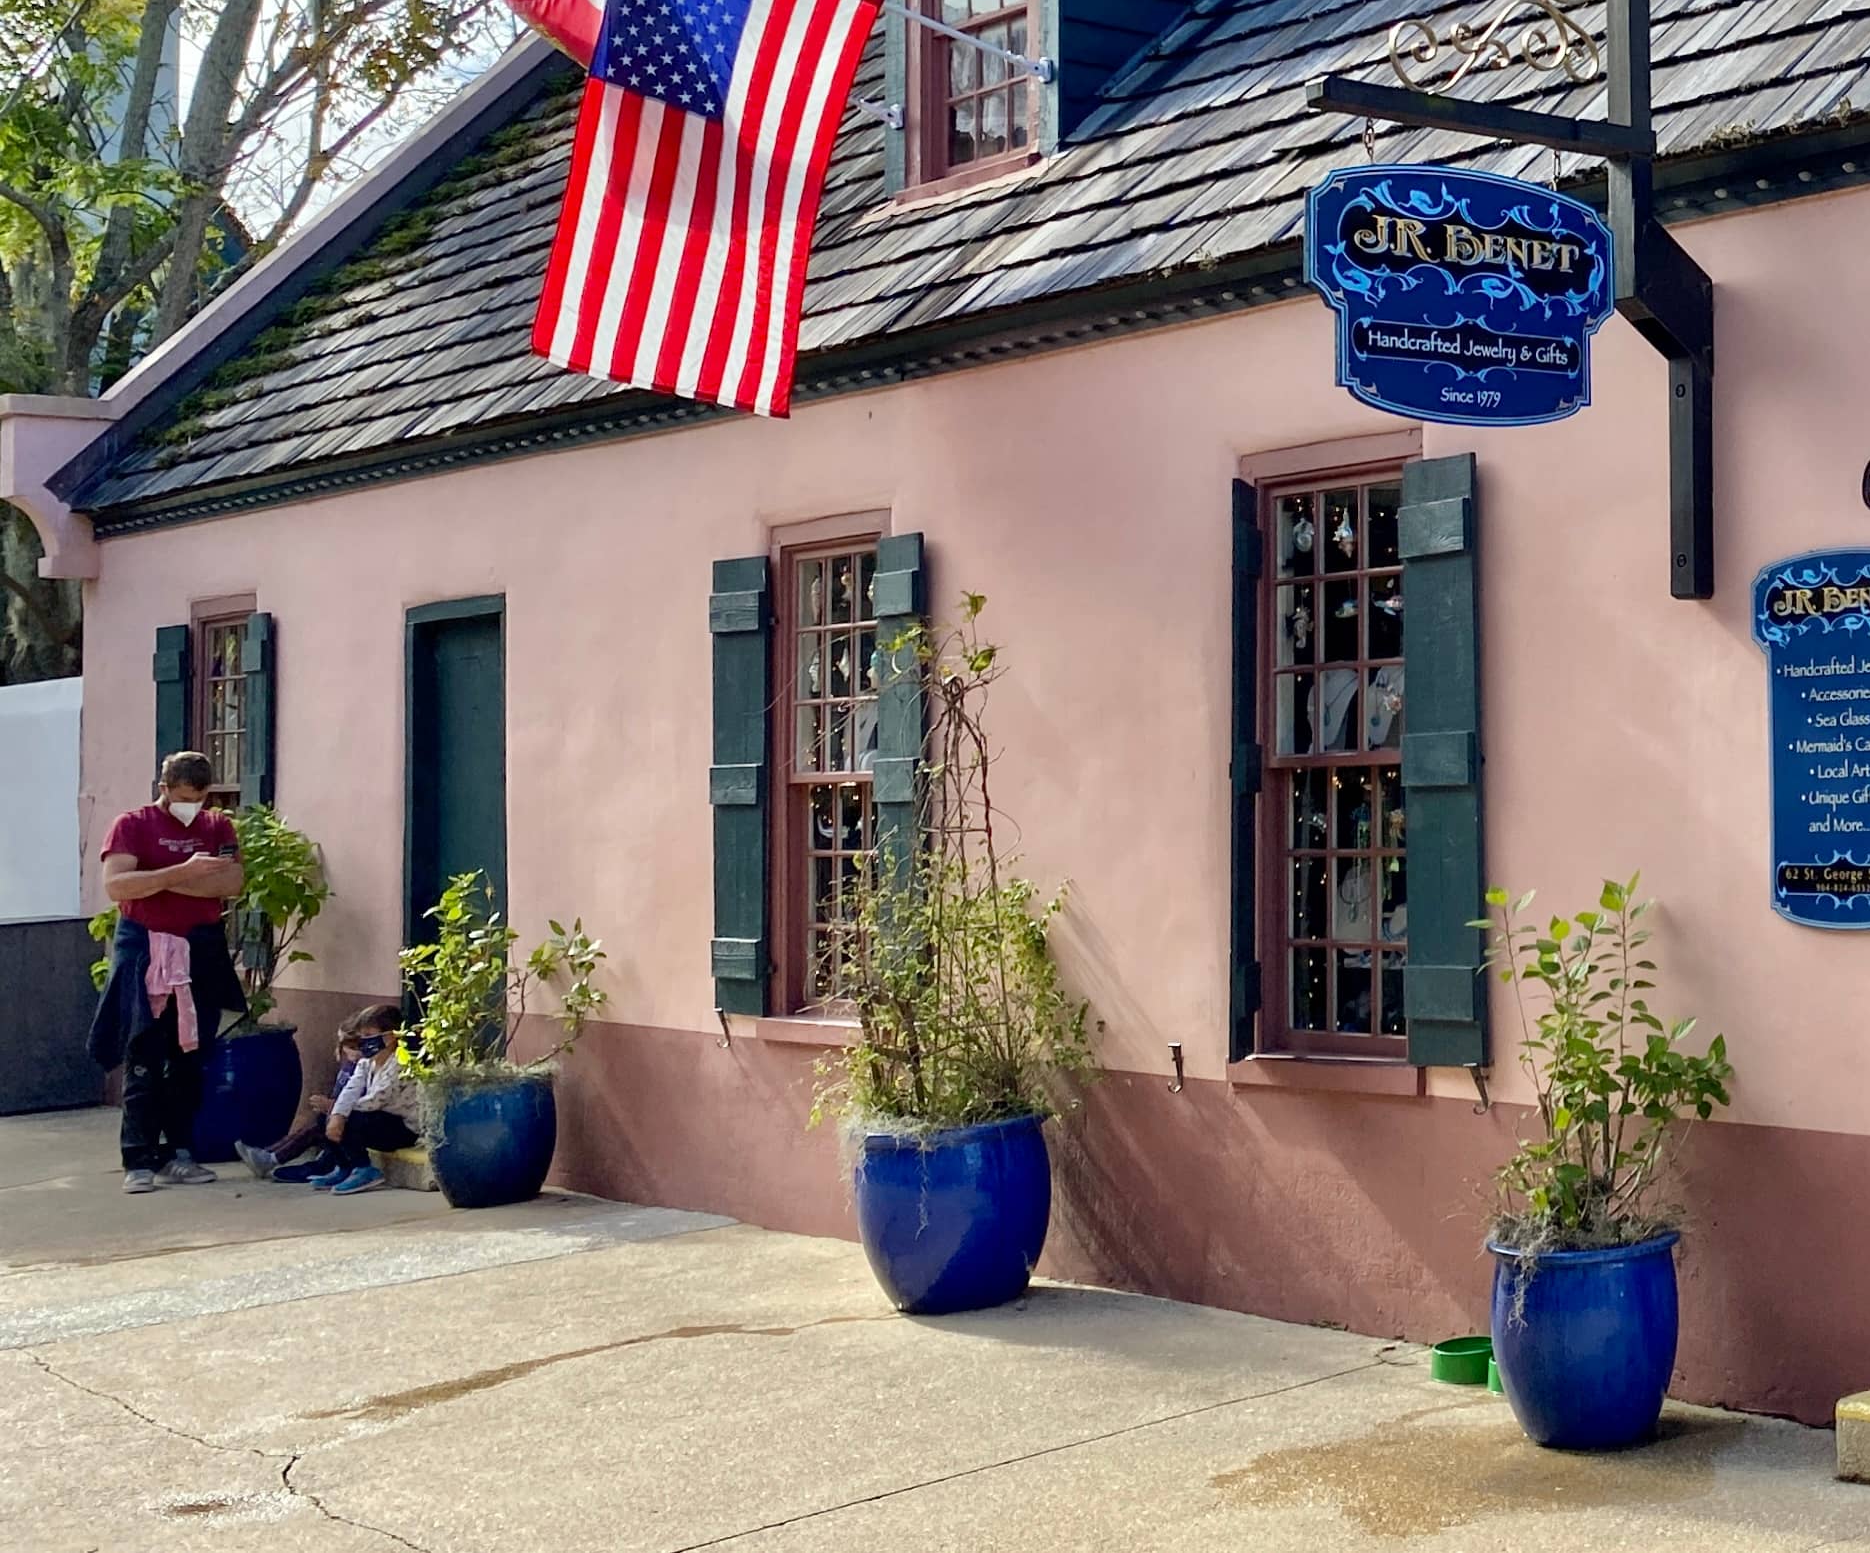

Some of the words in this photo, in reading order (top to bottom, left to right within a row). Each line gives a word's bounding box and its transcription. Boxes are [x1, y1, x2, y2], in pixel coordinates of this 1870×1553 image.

[1368, 328, 1461, 355] Handcrafted
[1464, 338, 1516, 367] Jewelry
[1520, 346, 1532, 361] &
[1535, 343, 1568, 365] Gifts
[1440, 387, 1474, 404] Since
[1477, 390, 1501, 408] 1979
[1784, 654, 1855, 678] Handcrafted
[1815, 713, 1837, 728] Sea
[1839, 707, 1870, 726] Glass
[1796, 733, 1852, 753] Mermaid's
[1817, 758, 1848, 778] Local
[1850, 763, 1870, 778] Art
[1808, 789, 1850, 812] Unique
[1808, 813, 1830, 832] and
[1785, 867, 1799, 880] 62
[1823, 868, 1863, 884] George
